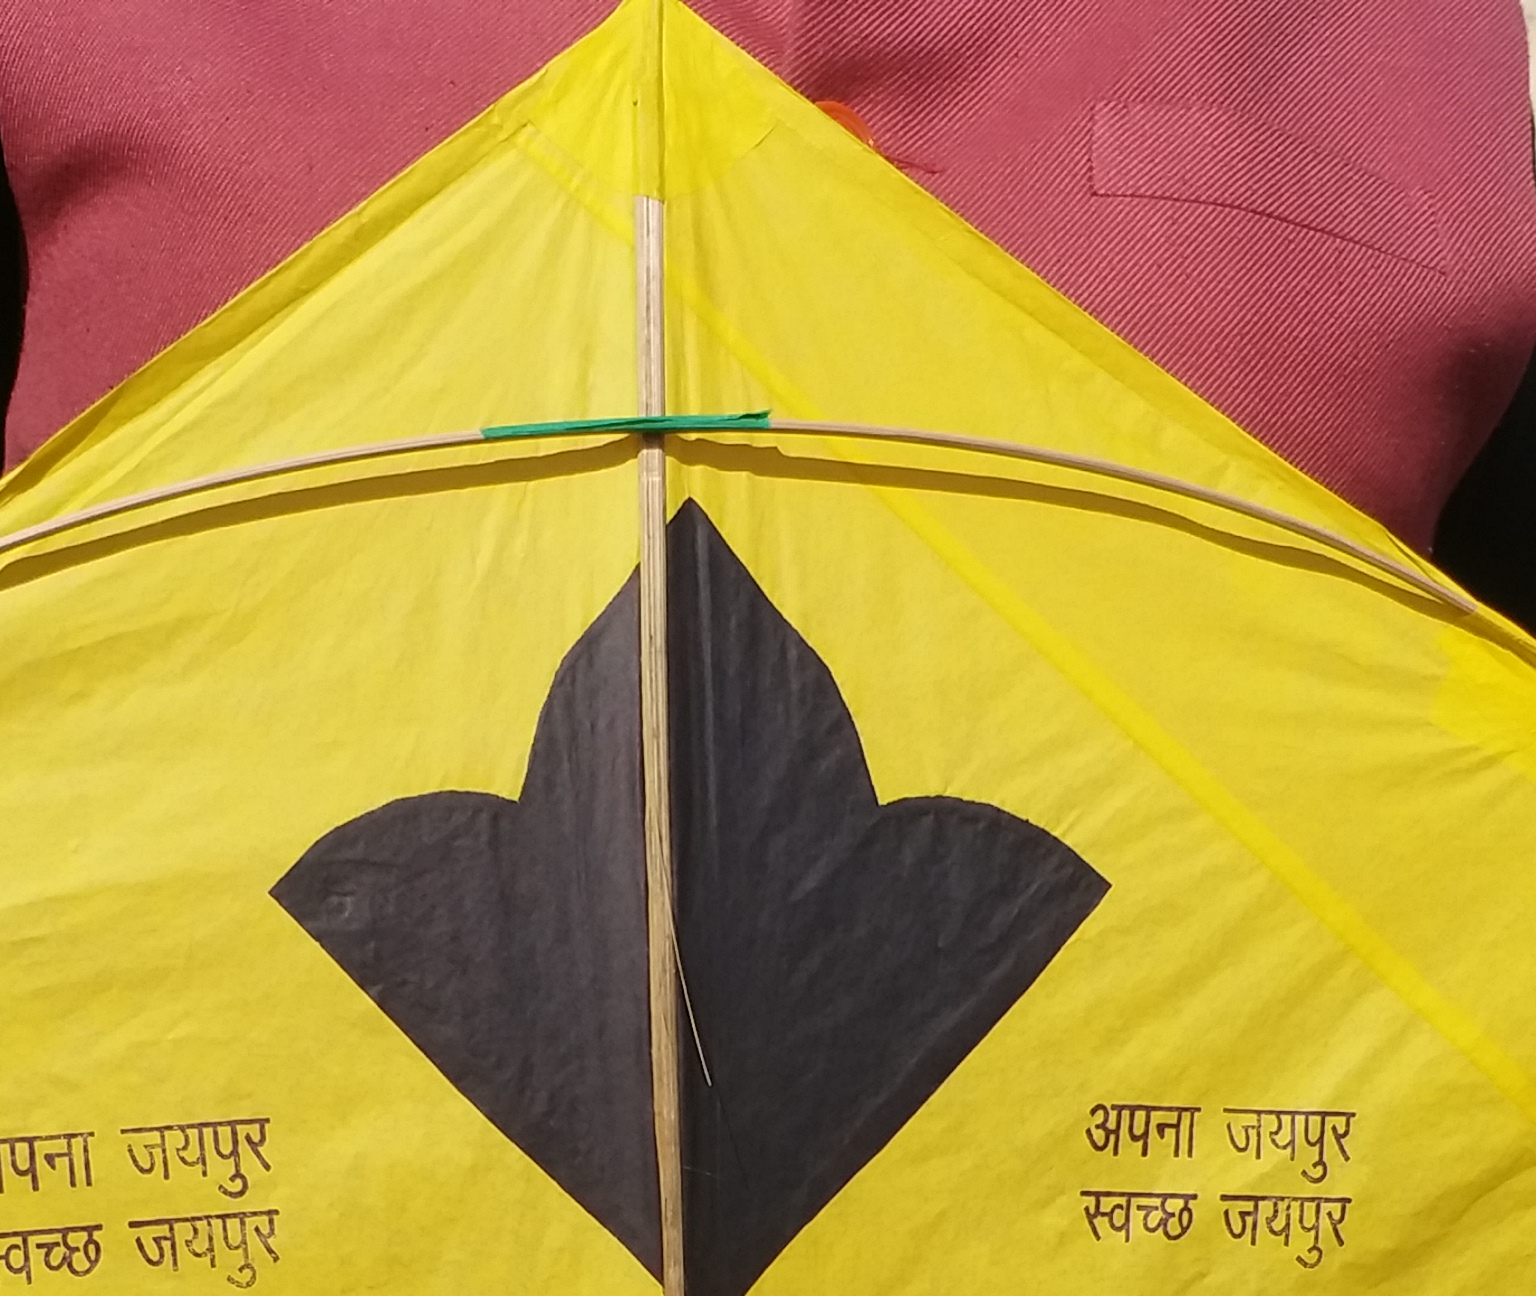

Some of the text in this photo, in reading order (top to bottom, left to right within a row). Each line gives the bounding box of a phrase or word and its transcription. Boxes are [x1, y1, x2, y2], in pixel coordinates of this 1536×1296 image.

[120, 1117, 272, 1199] जयपुर
[1085, 1103, 1357, 1184] अपना जयपुर
[128, 1208, 280, 1289] जयपुर
[1079, 1190, 1353, 1269] स्वच्छ जयपुर
